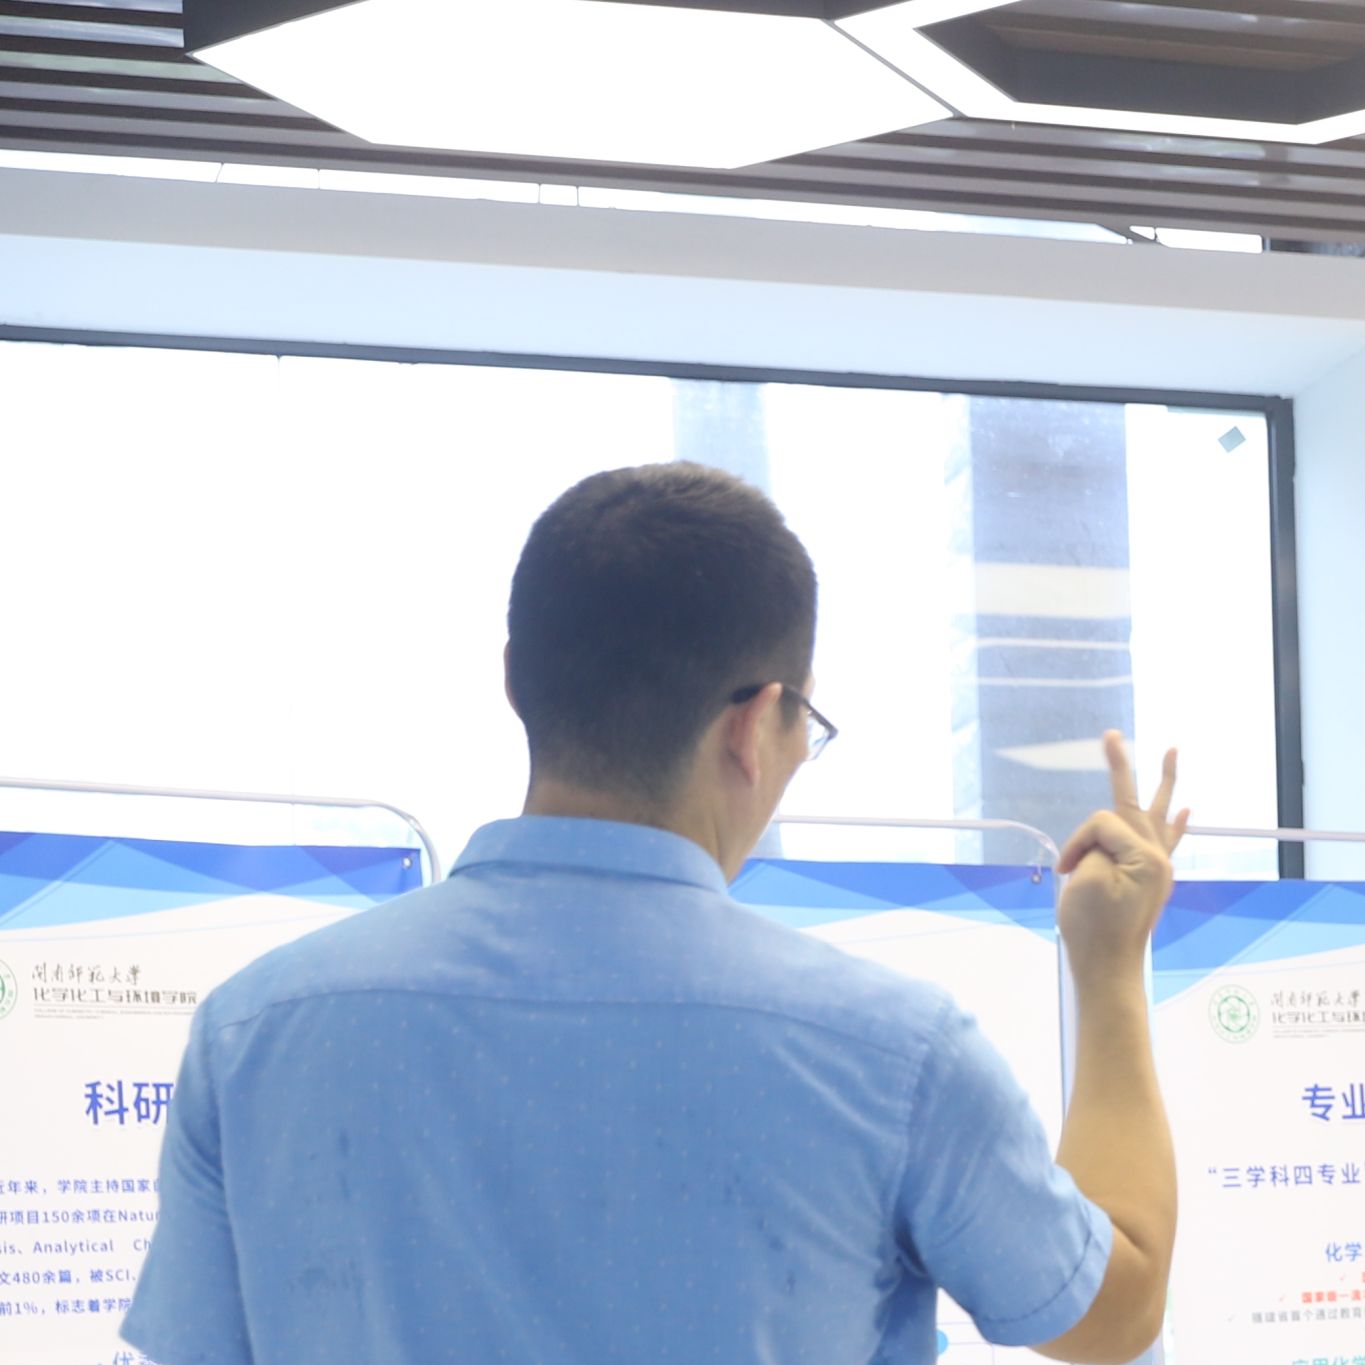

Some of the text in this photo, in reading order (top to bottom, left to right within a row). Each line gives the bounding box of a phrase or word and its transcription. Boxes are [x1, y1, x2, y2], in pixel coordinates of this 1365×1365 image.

[84, 1080, 174, 1125] 科研
[0, 1178, 160, 1194] 年来，学院主持国家
